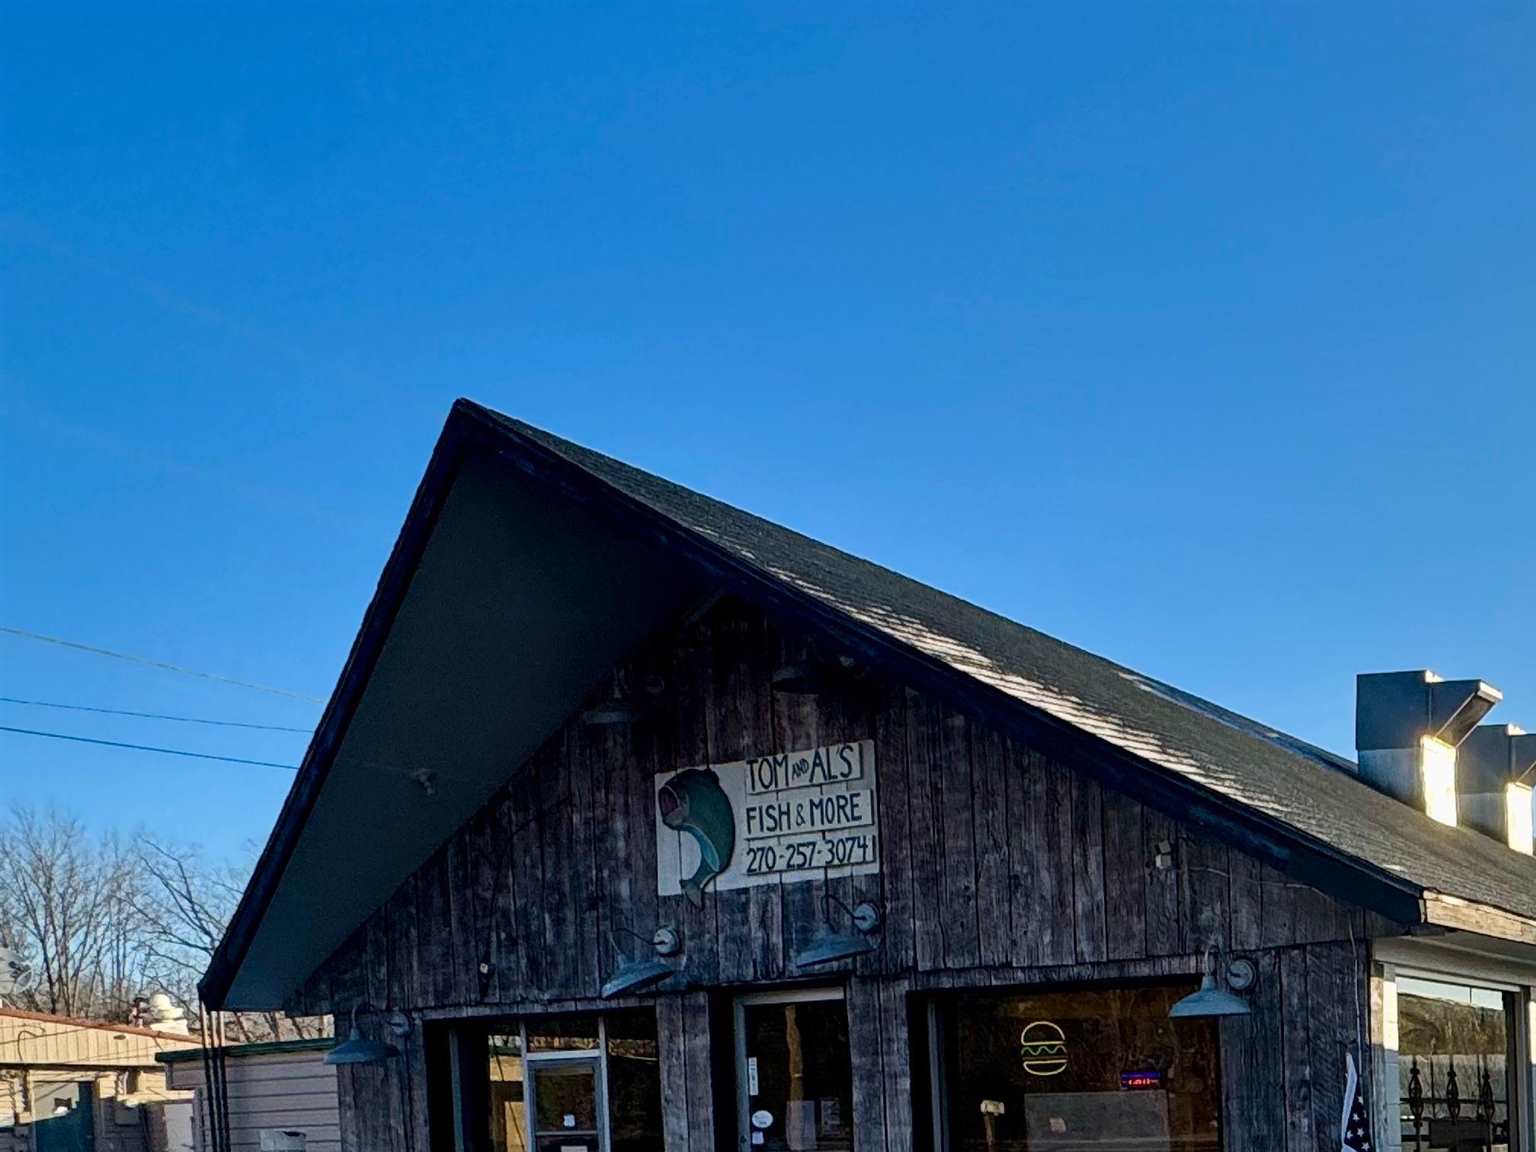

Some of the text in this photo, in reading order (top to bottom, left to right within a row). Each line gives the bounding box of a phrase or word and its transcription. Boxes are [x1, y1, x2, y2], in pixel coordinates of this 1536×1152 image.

[746, 754, 789, 792] TOM
[792, 758, 810, 781] AND
[746, 793, 863, 835] FISH & MORE
[746, 835, 869, 873] 270-257-3074
